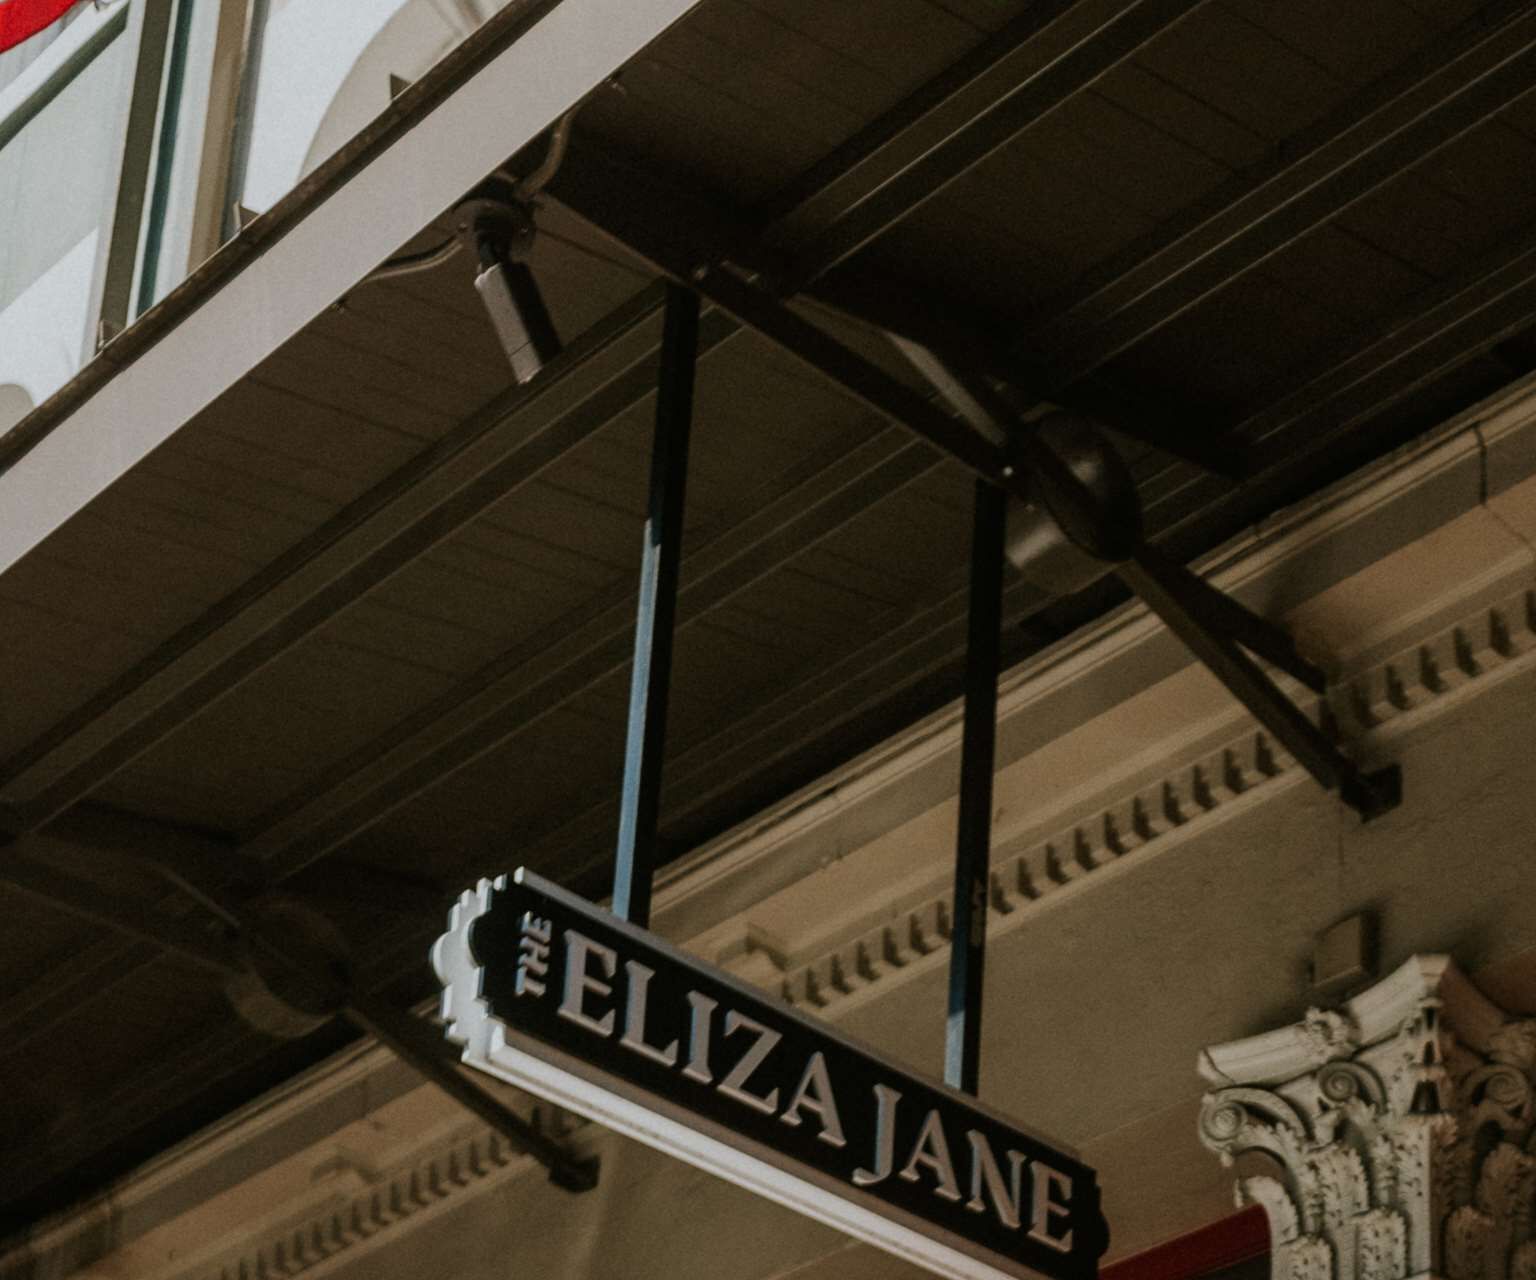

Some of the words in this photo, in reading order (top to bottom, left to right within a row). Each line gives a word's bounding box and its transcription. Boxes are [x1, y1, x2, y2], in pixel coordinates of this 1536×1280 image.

[515, 910, 552, 997] THE
[557, 928, 847, 1147] ELIZA
[852, 1082, 1074, 1253] JANE
